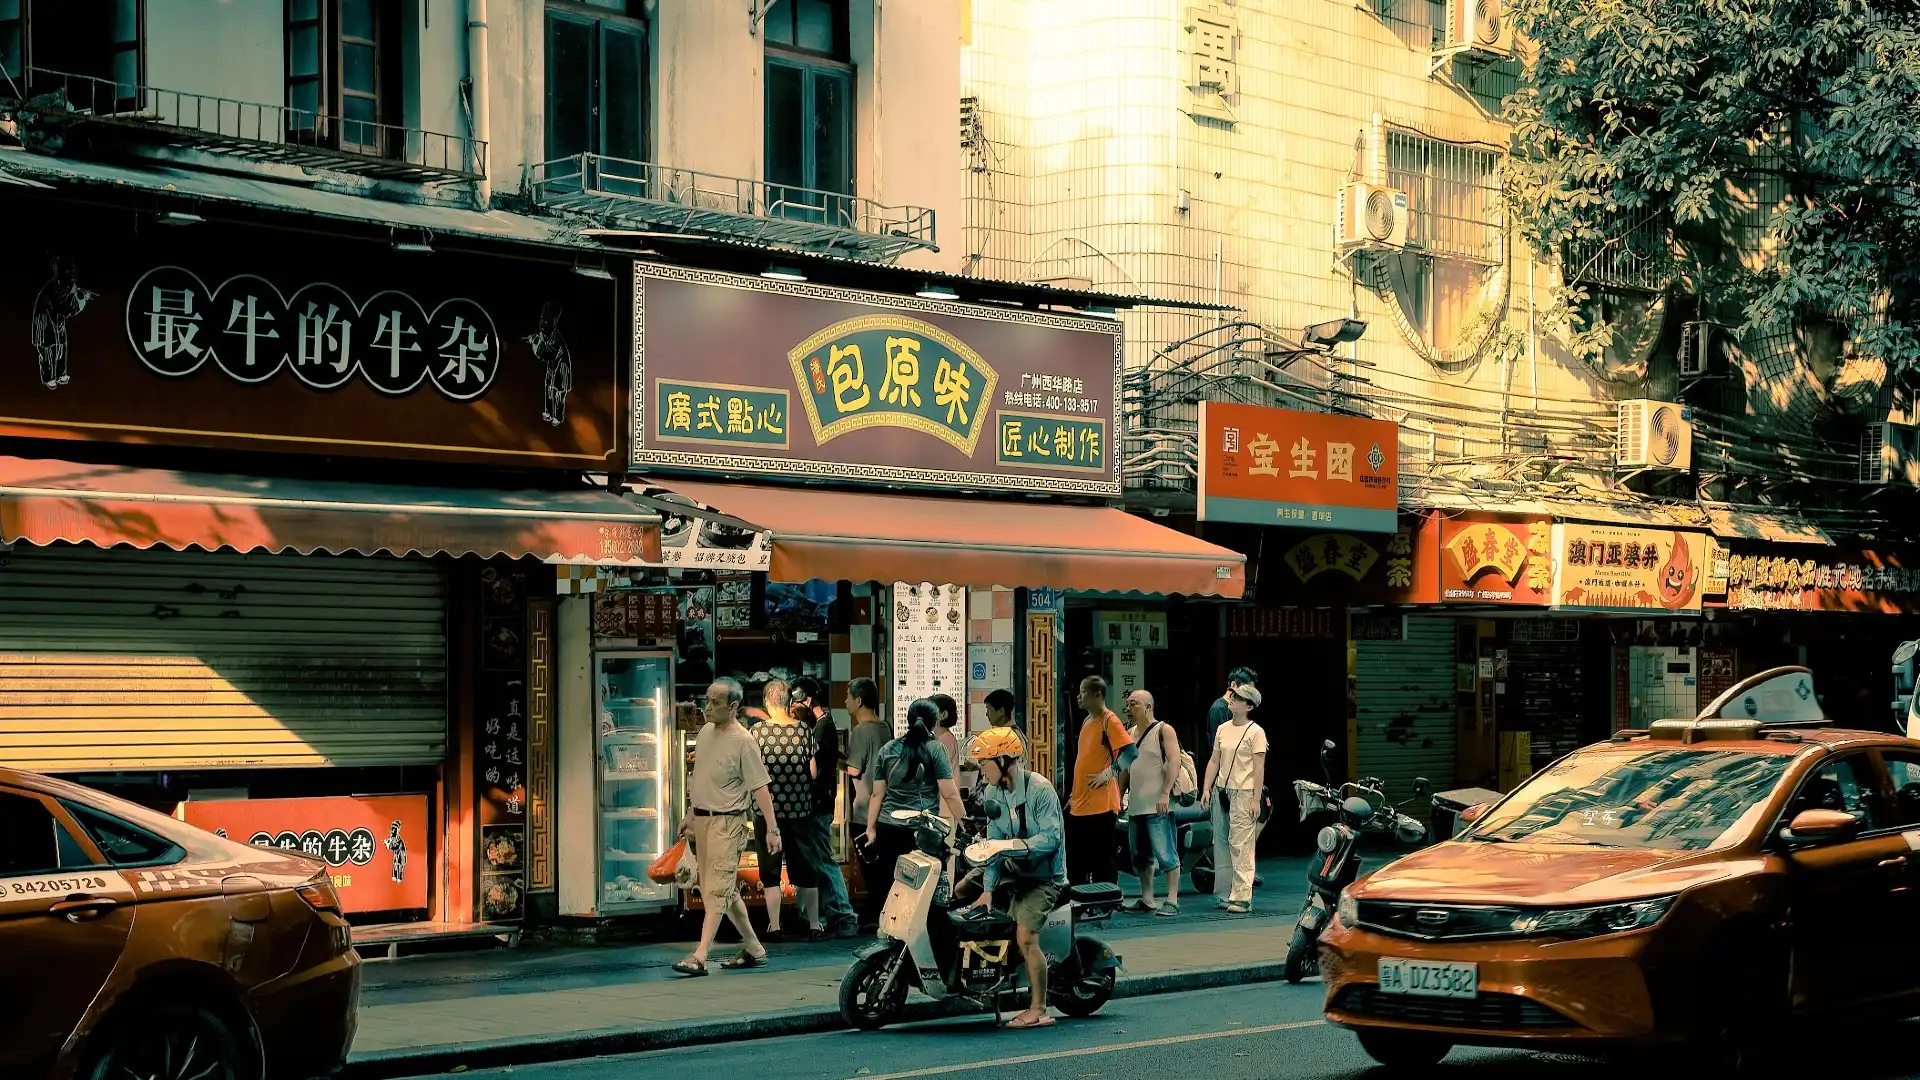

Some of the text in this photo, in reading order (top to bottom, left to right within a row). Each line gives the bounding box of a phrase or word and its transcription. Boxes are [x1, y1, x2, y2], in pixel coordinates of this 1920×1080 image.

[143, 286, 489, 385] 最牛的牛杂
[826, 335, 971, 426] 包原味
[1021, 373, 1083, 394] 广州西华路店
[665, 391, 784, 436] 廣式點心
[1002, 421, 1100, 463] 匠心制作
[1247, 432, 1357, 483] 宝生园
[695, 552, 747, 564] 招牌叉烧包
[1567, 538, 1660, 570] 澳门亚婆井
[1031, 593, 1051, 607] 504
[484, 716, 501, 785] 好吃的
[506, 679, 523, 816] 一直是这味道
[1583, 809, 1618, 827] 空车
[1410, 966, 1474, 992] DZ3582
